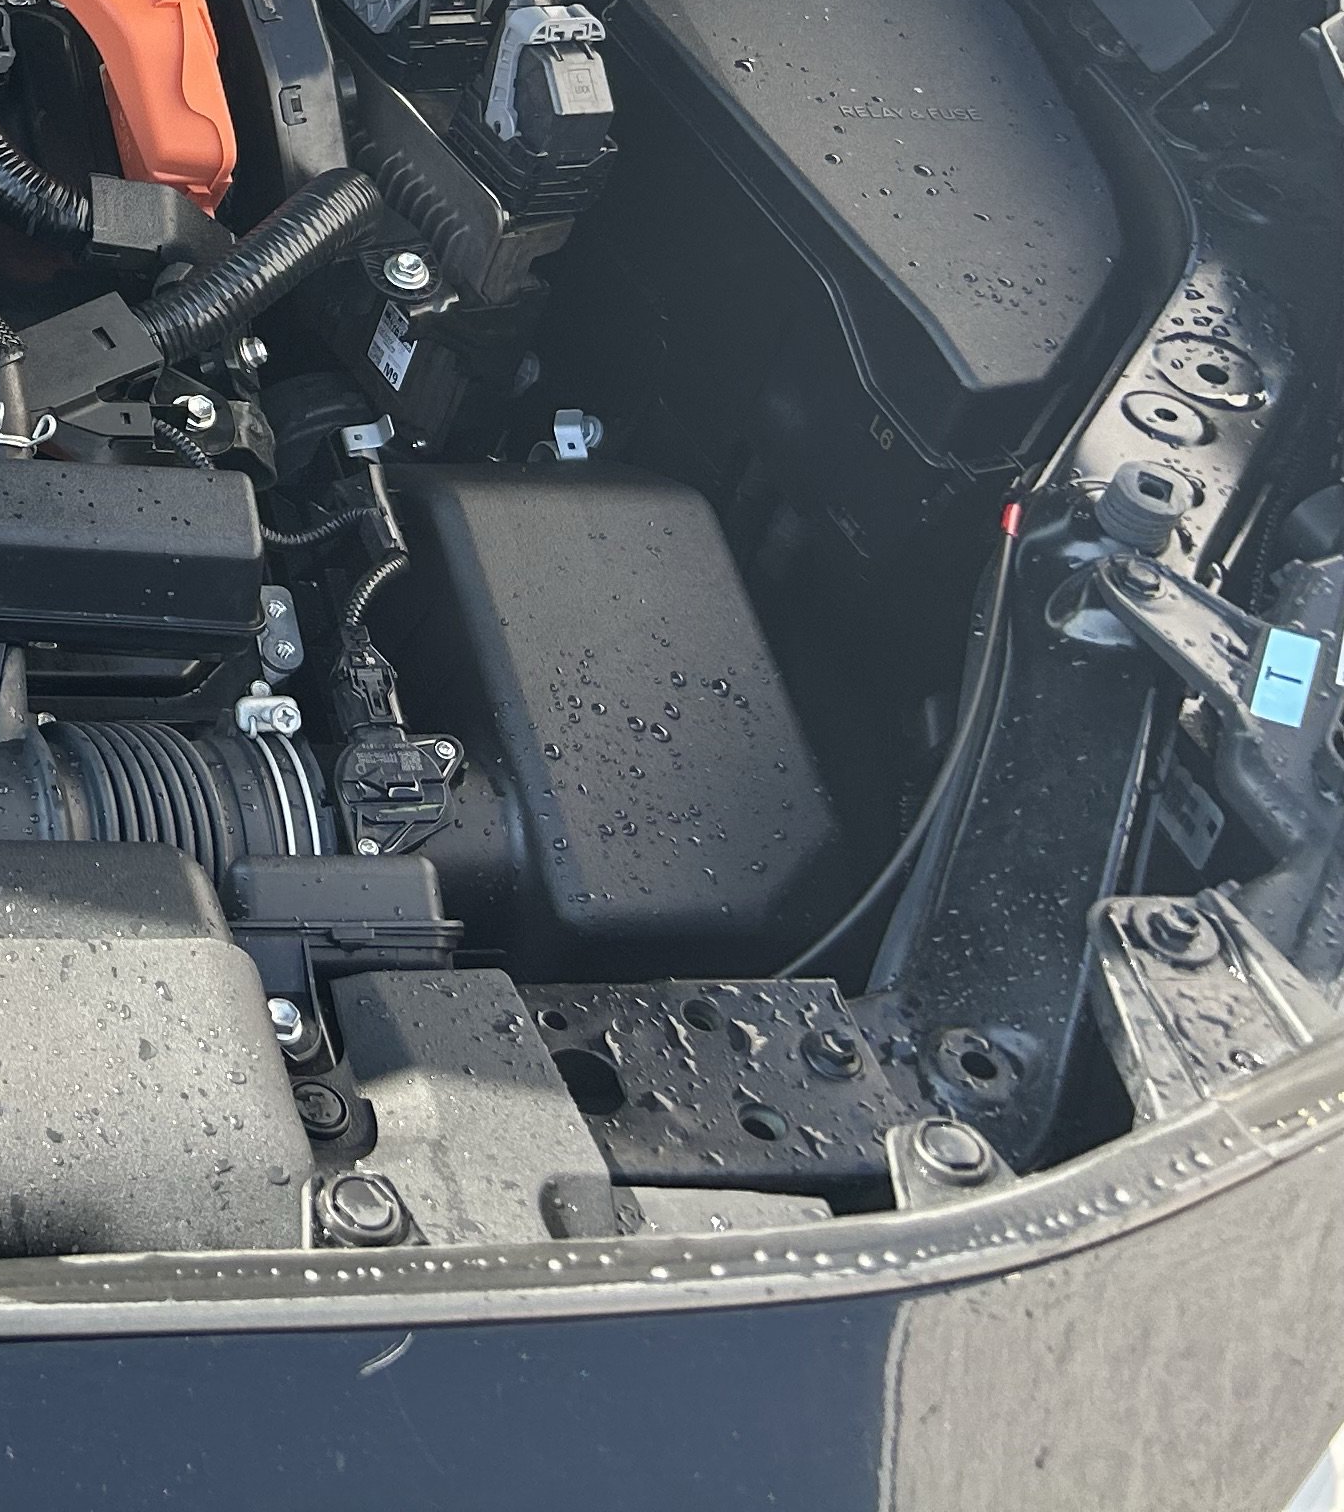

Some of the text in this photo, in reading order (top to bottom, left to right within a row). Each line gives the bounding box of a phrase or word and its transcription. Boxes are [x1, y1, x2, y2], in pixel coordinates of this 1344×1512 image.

[838, 105, 983, 121] RELAY & FUSE
[383, 362, 399, 384] M9
[869, 414, 895, 450] L6
